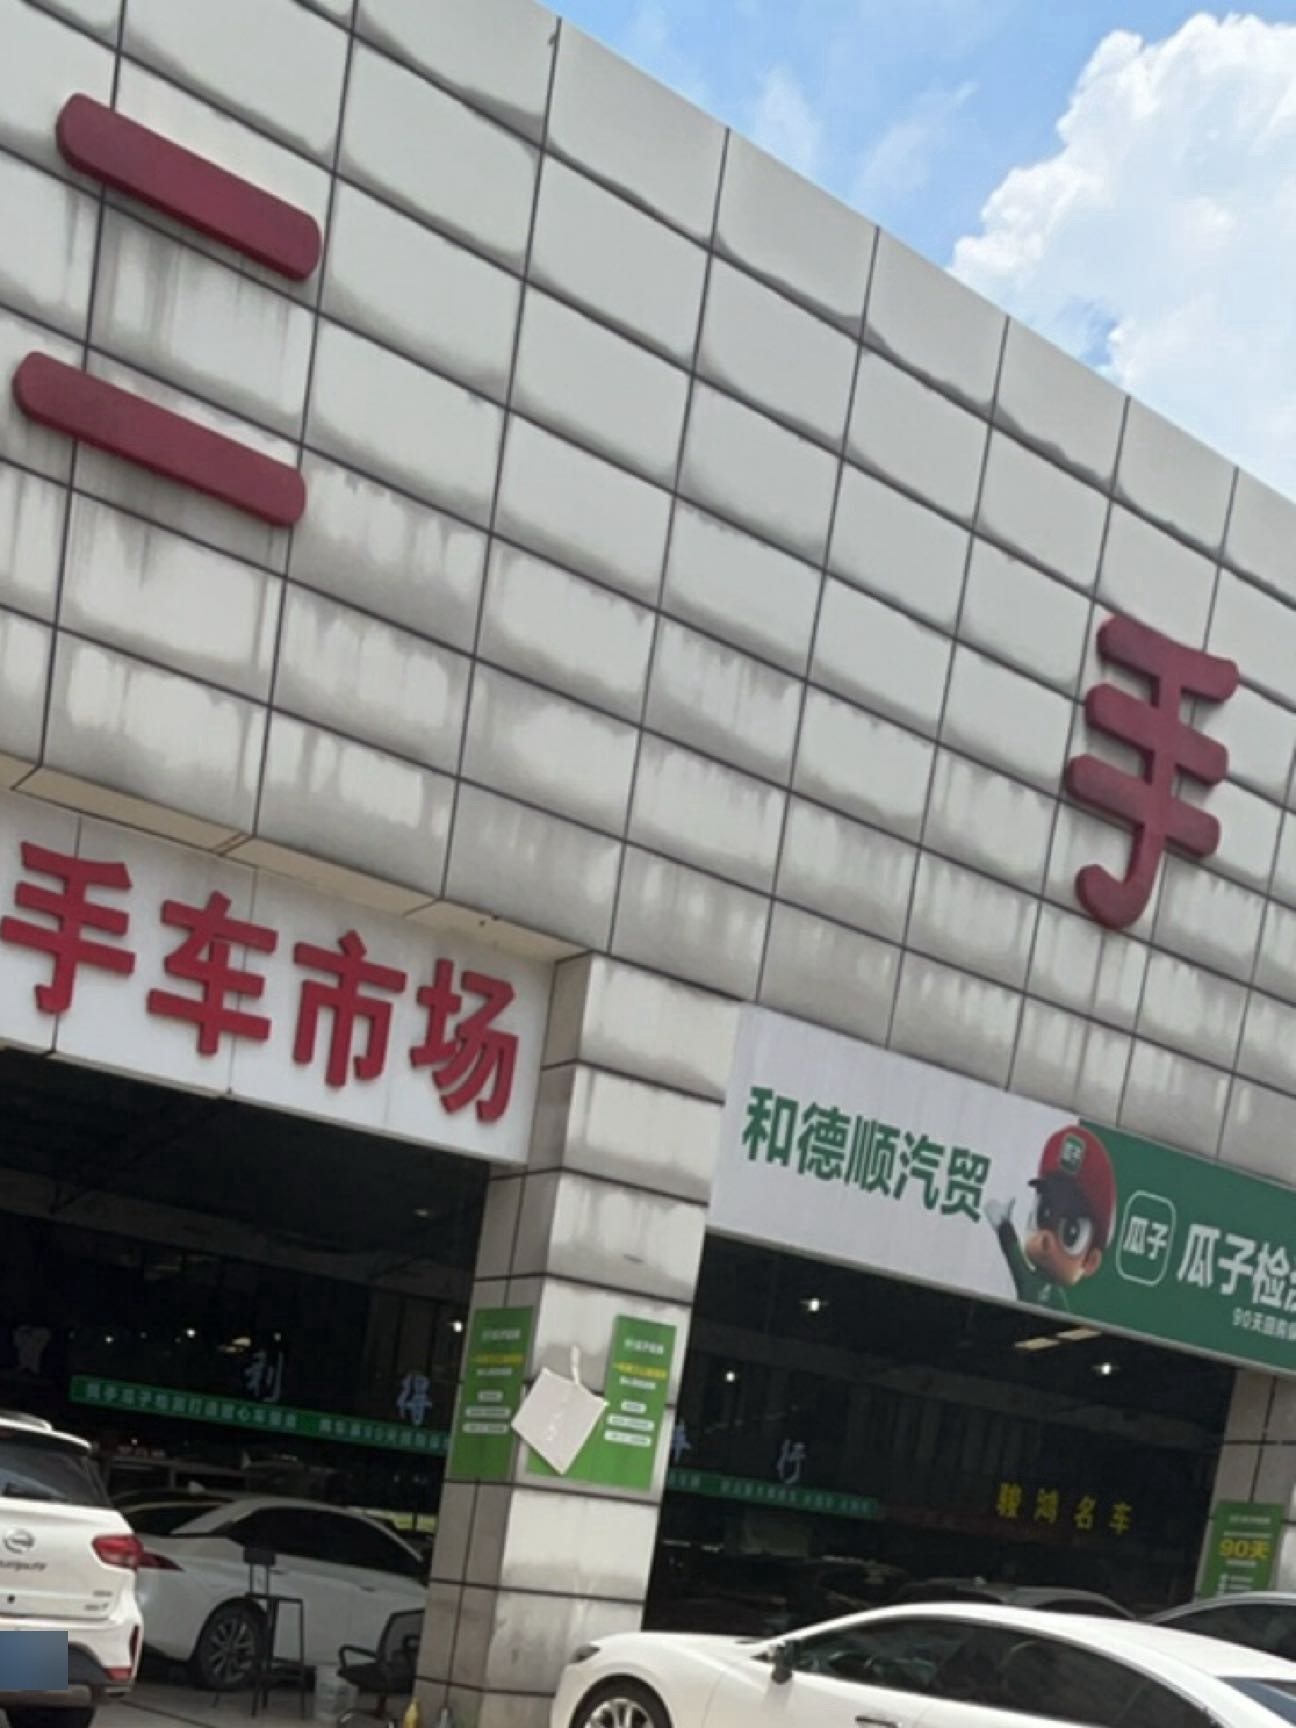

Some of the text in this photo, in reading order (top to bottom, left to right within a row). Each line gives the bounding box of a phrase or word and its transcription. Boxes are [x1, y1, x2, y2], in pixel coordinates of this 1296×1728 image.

[12, 92, 1239, 930] 二 手
[741, 1086, 992, 1223] 和德顺汽贸
[1122, 1215, 1170, 1262] 瓜子
